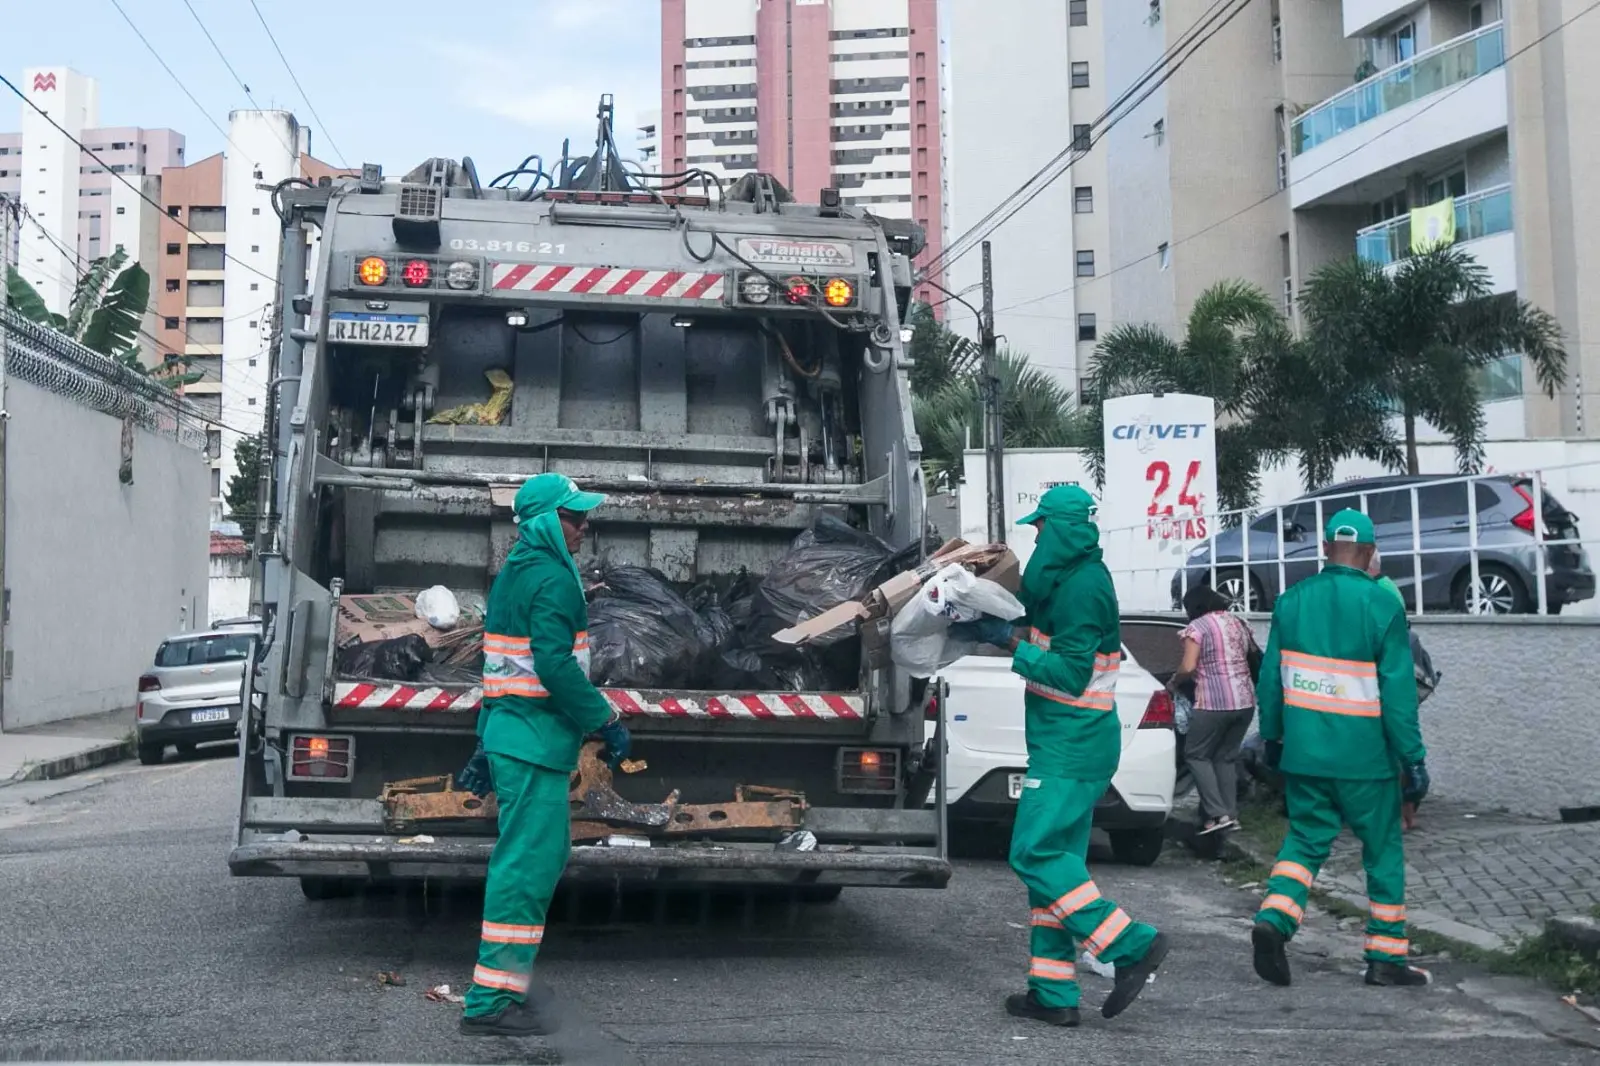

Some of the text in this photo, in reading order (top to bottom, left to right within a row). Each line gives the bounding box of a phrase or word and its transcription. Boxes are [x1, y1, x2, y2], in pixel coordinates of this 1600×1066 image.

[450, 239, 566, 254] 03.816.21
[759, 242, 838, 257] Planalto
[335, 321, 417, 342] RIH2A27
[1145, 460, 1205, 517] 24
